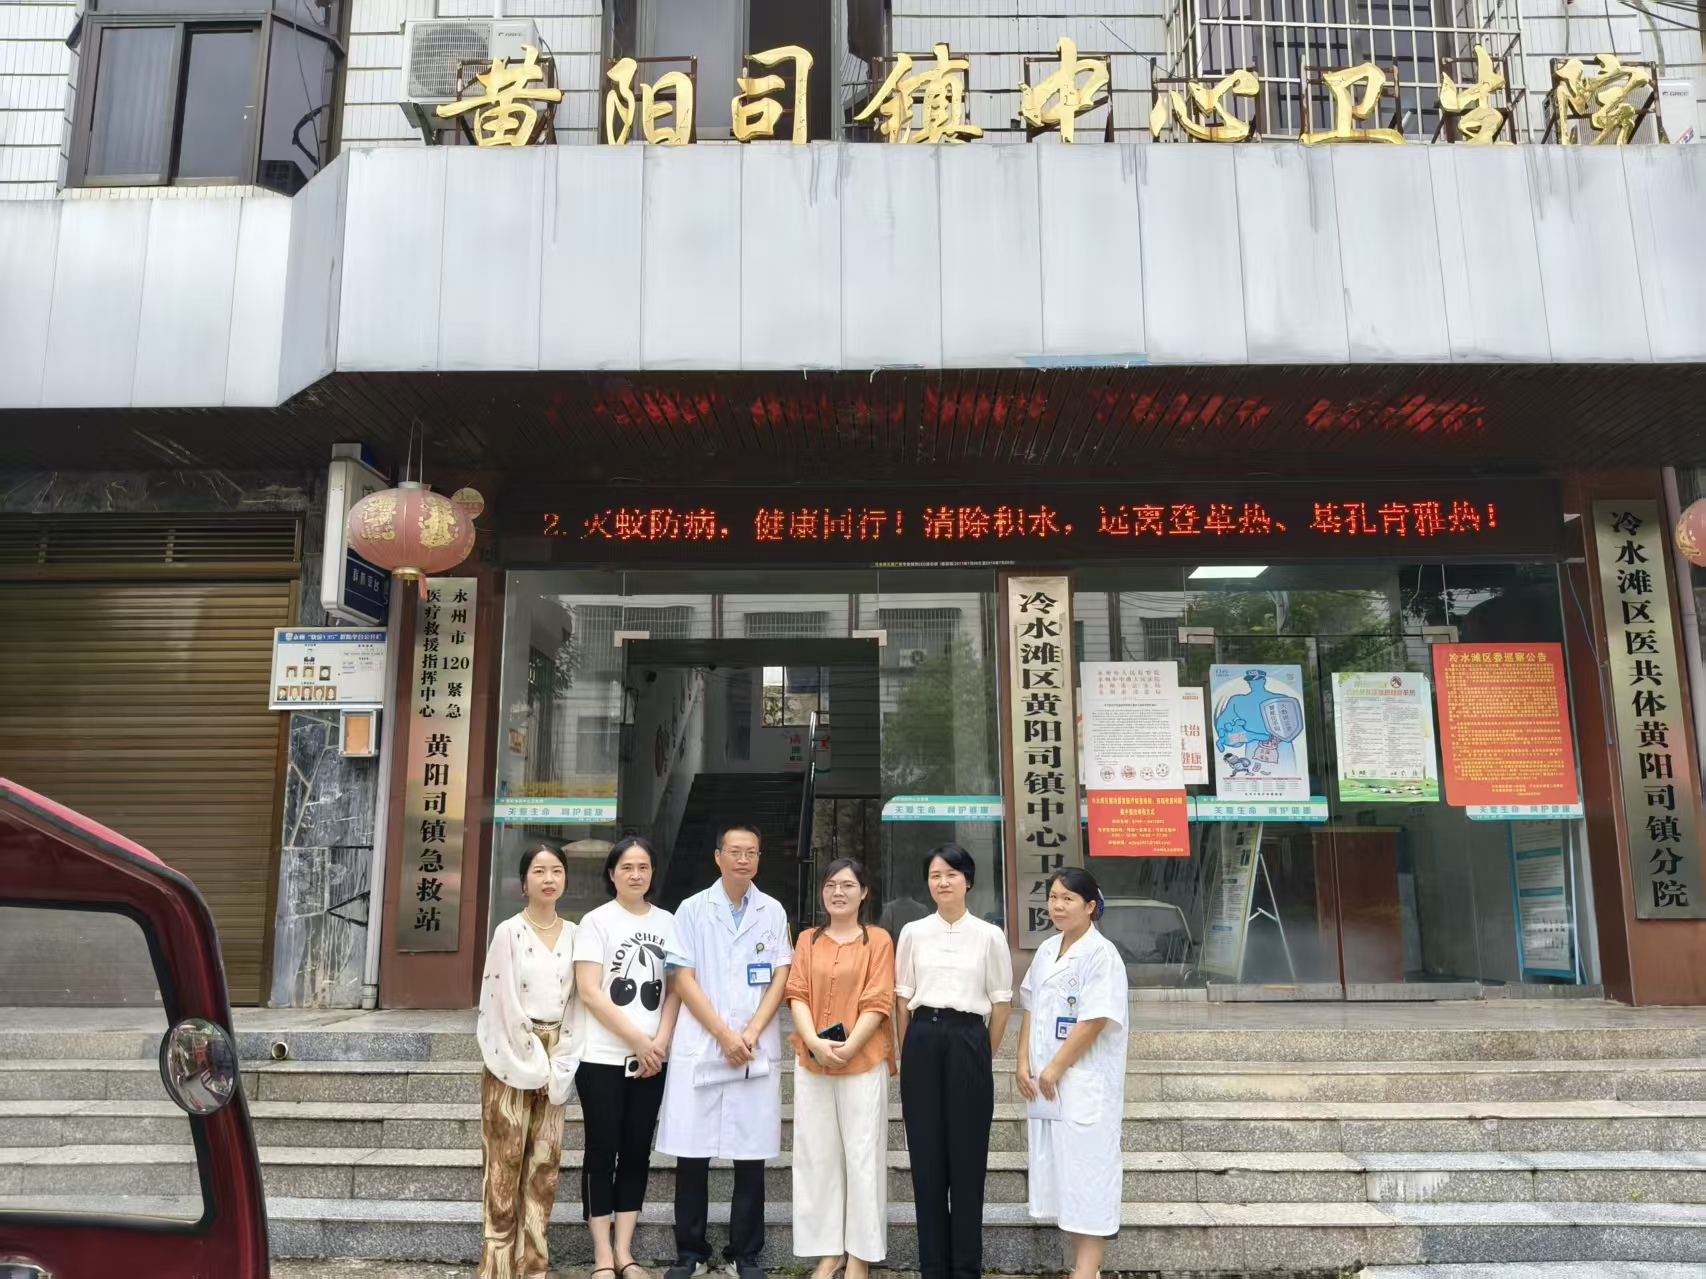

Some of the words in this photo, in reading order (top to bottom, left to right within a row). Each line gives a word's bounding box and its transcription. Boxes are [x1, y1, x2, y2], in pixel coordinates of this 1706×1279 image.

[419, 589, 441, 719] 医疗救援指挥中心
[1610, 511, 1689, 908] 冷水滩区医共体黄阳司镇分院
[508, 807, 551, 816] 关爱生命
[560, 807, 604, 816] 呵护健康
[895, 805, 936, 814] 关爱生命
[1214, 806, 1257, 815] 关爱生命
[414, 733, 452, 932] 黄阳司镇急救站
[610, 940, 633, 974] MON
